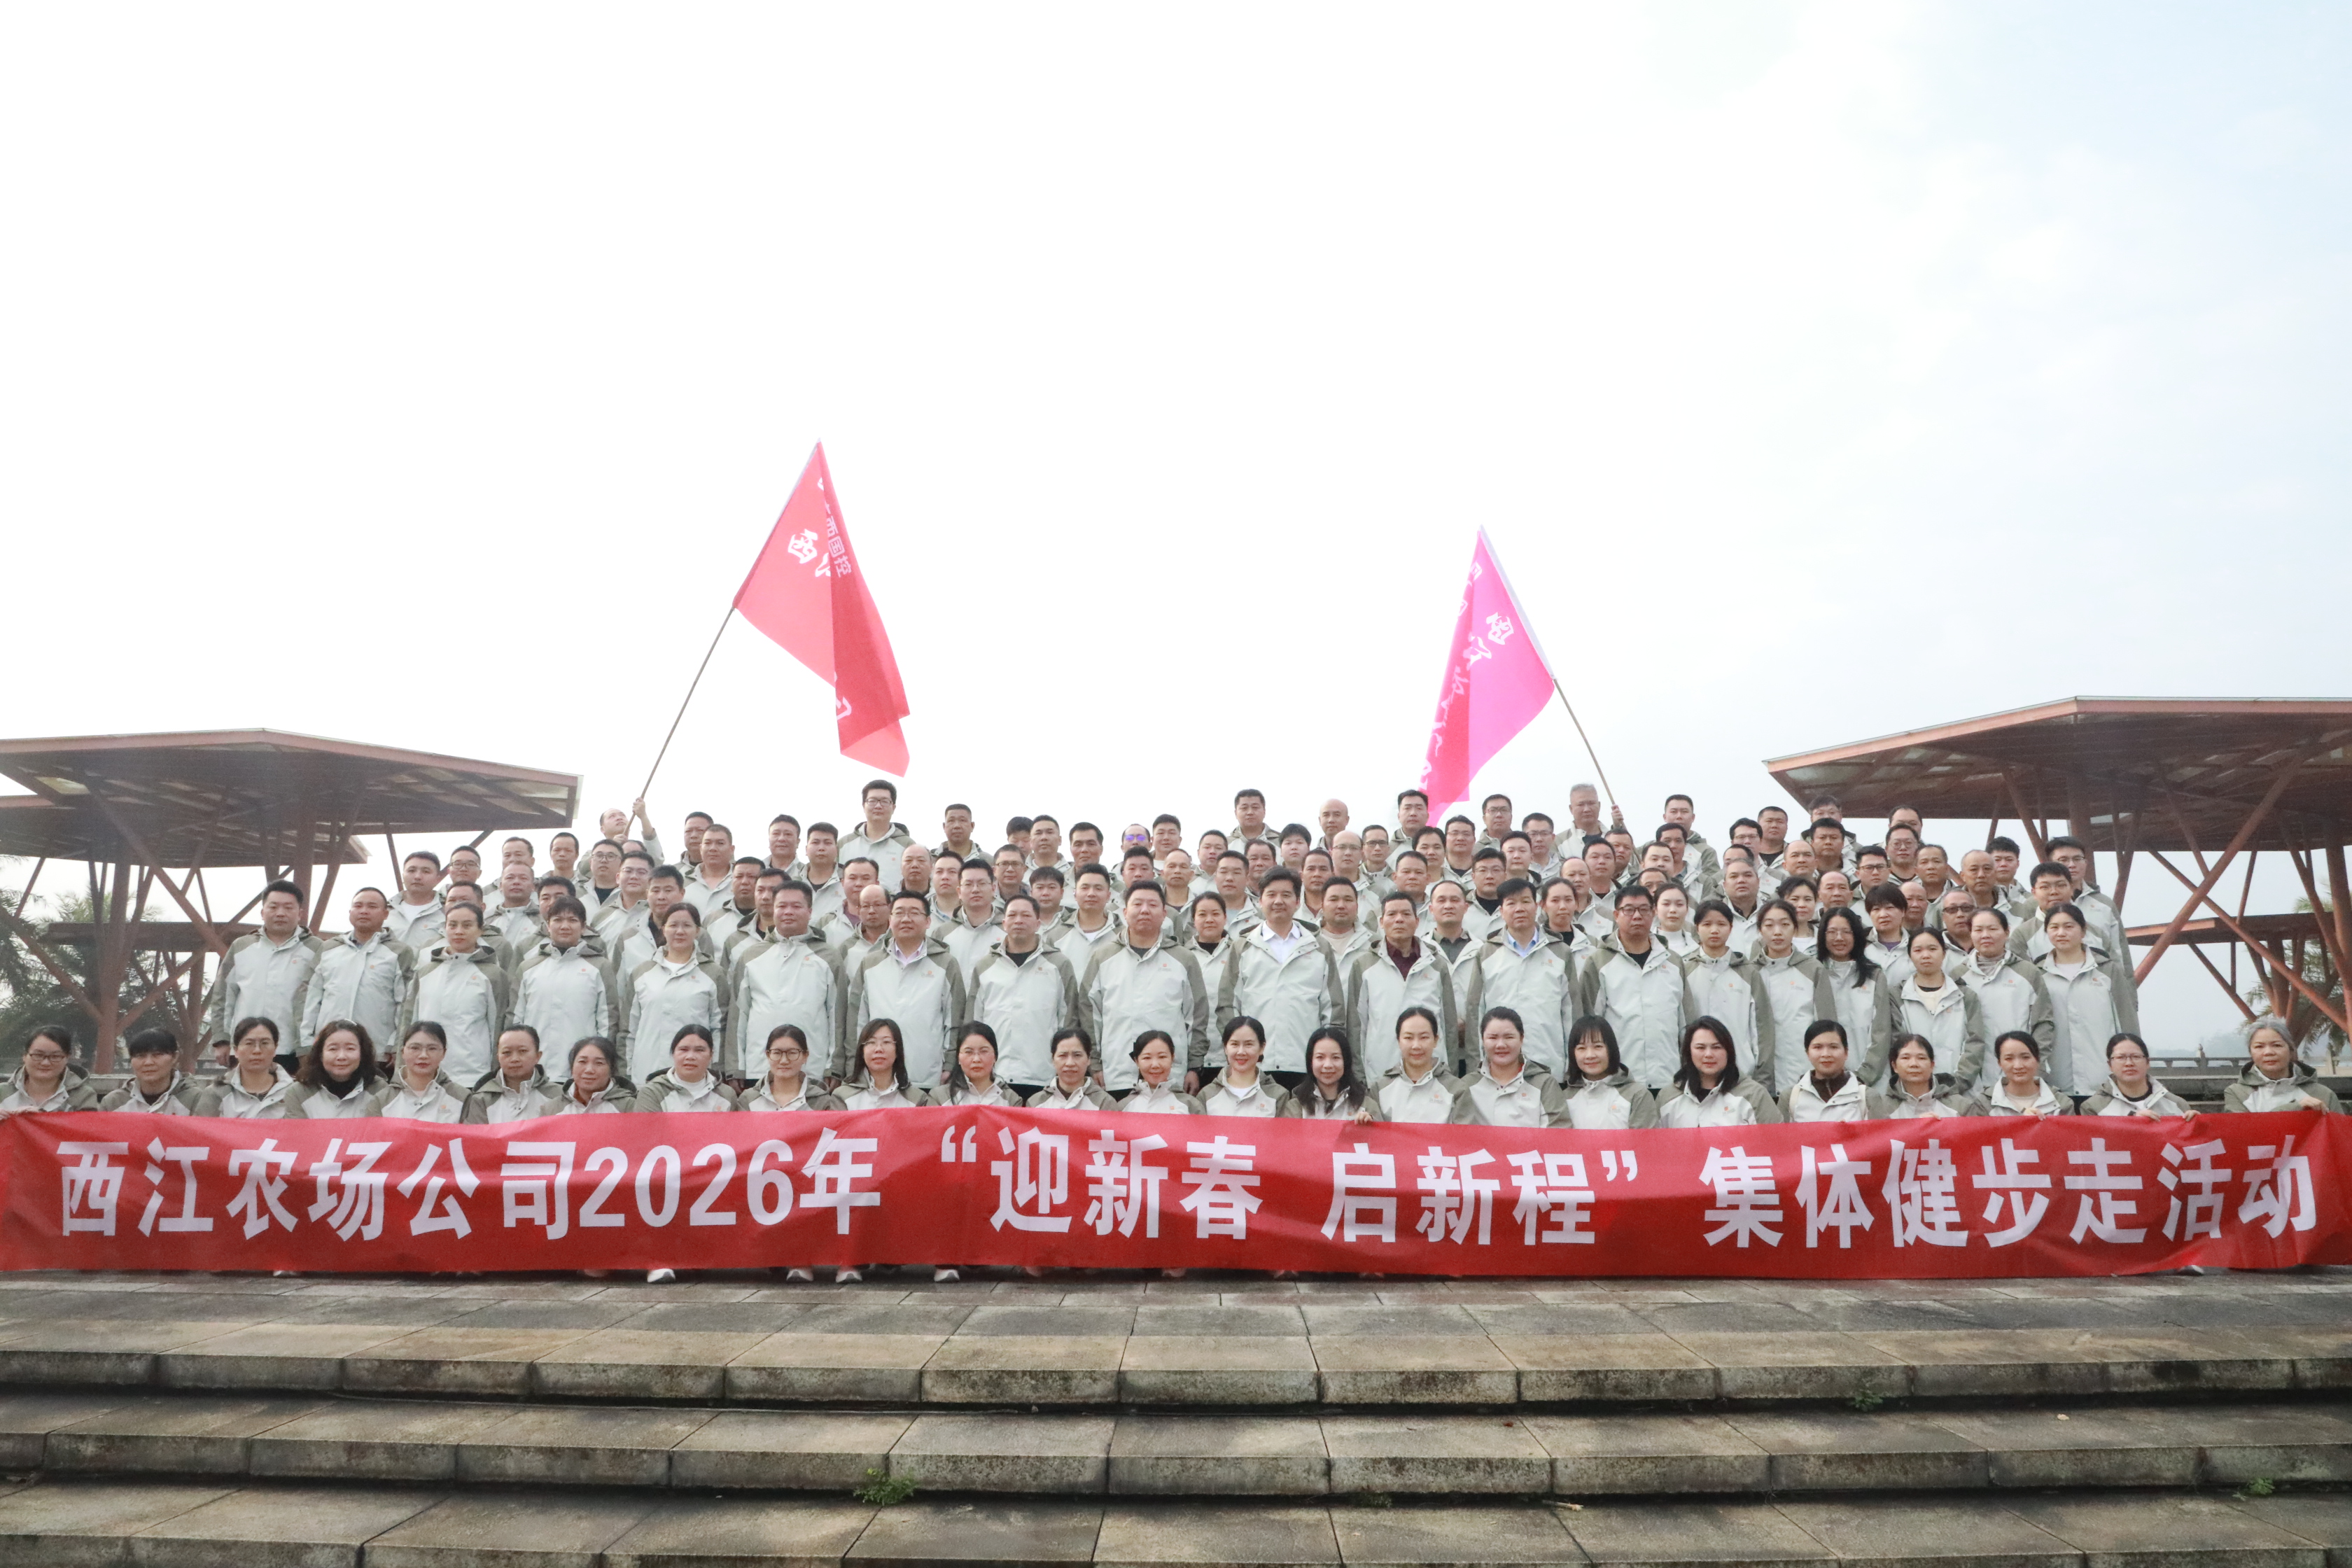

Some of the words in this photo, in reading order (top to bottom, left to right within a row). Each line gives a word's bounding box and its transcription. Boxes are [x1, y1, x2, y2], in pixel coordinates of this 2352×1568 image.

[57, 1127, 881, 1241] 西江农场公司2026年
[1699, 1134, 2316, 1248] 集体健步走活动
